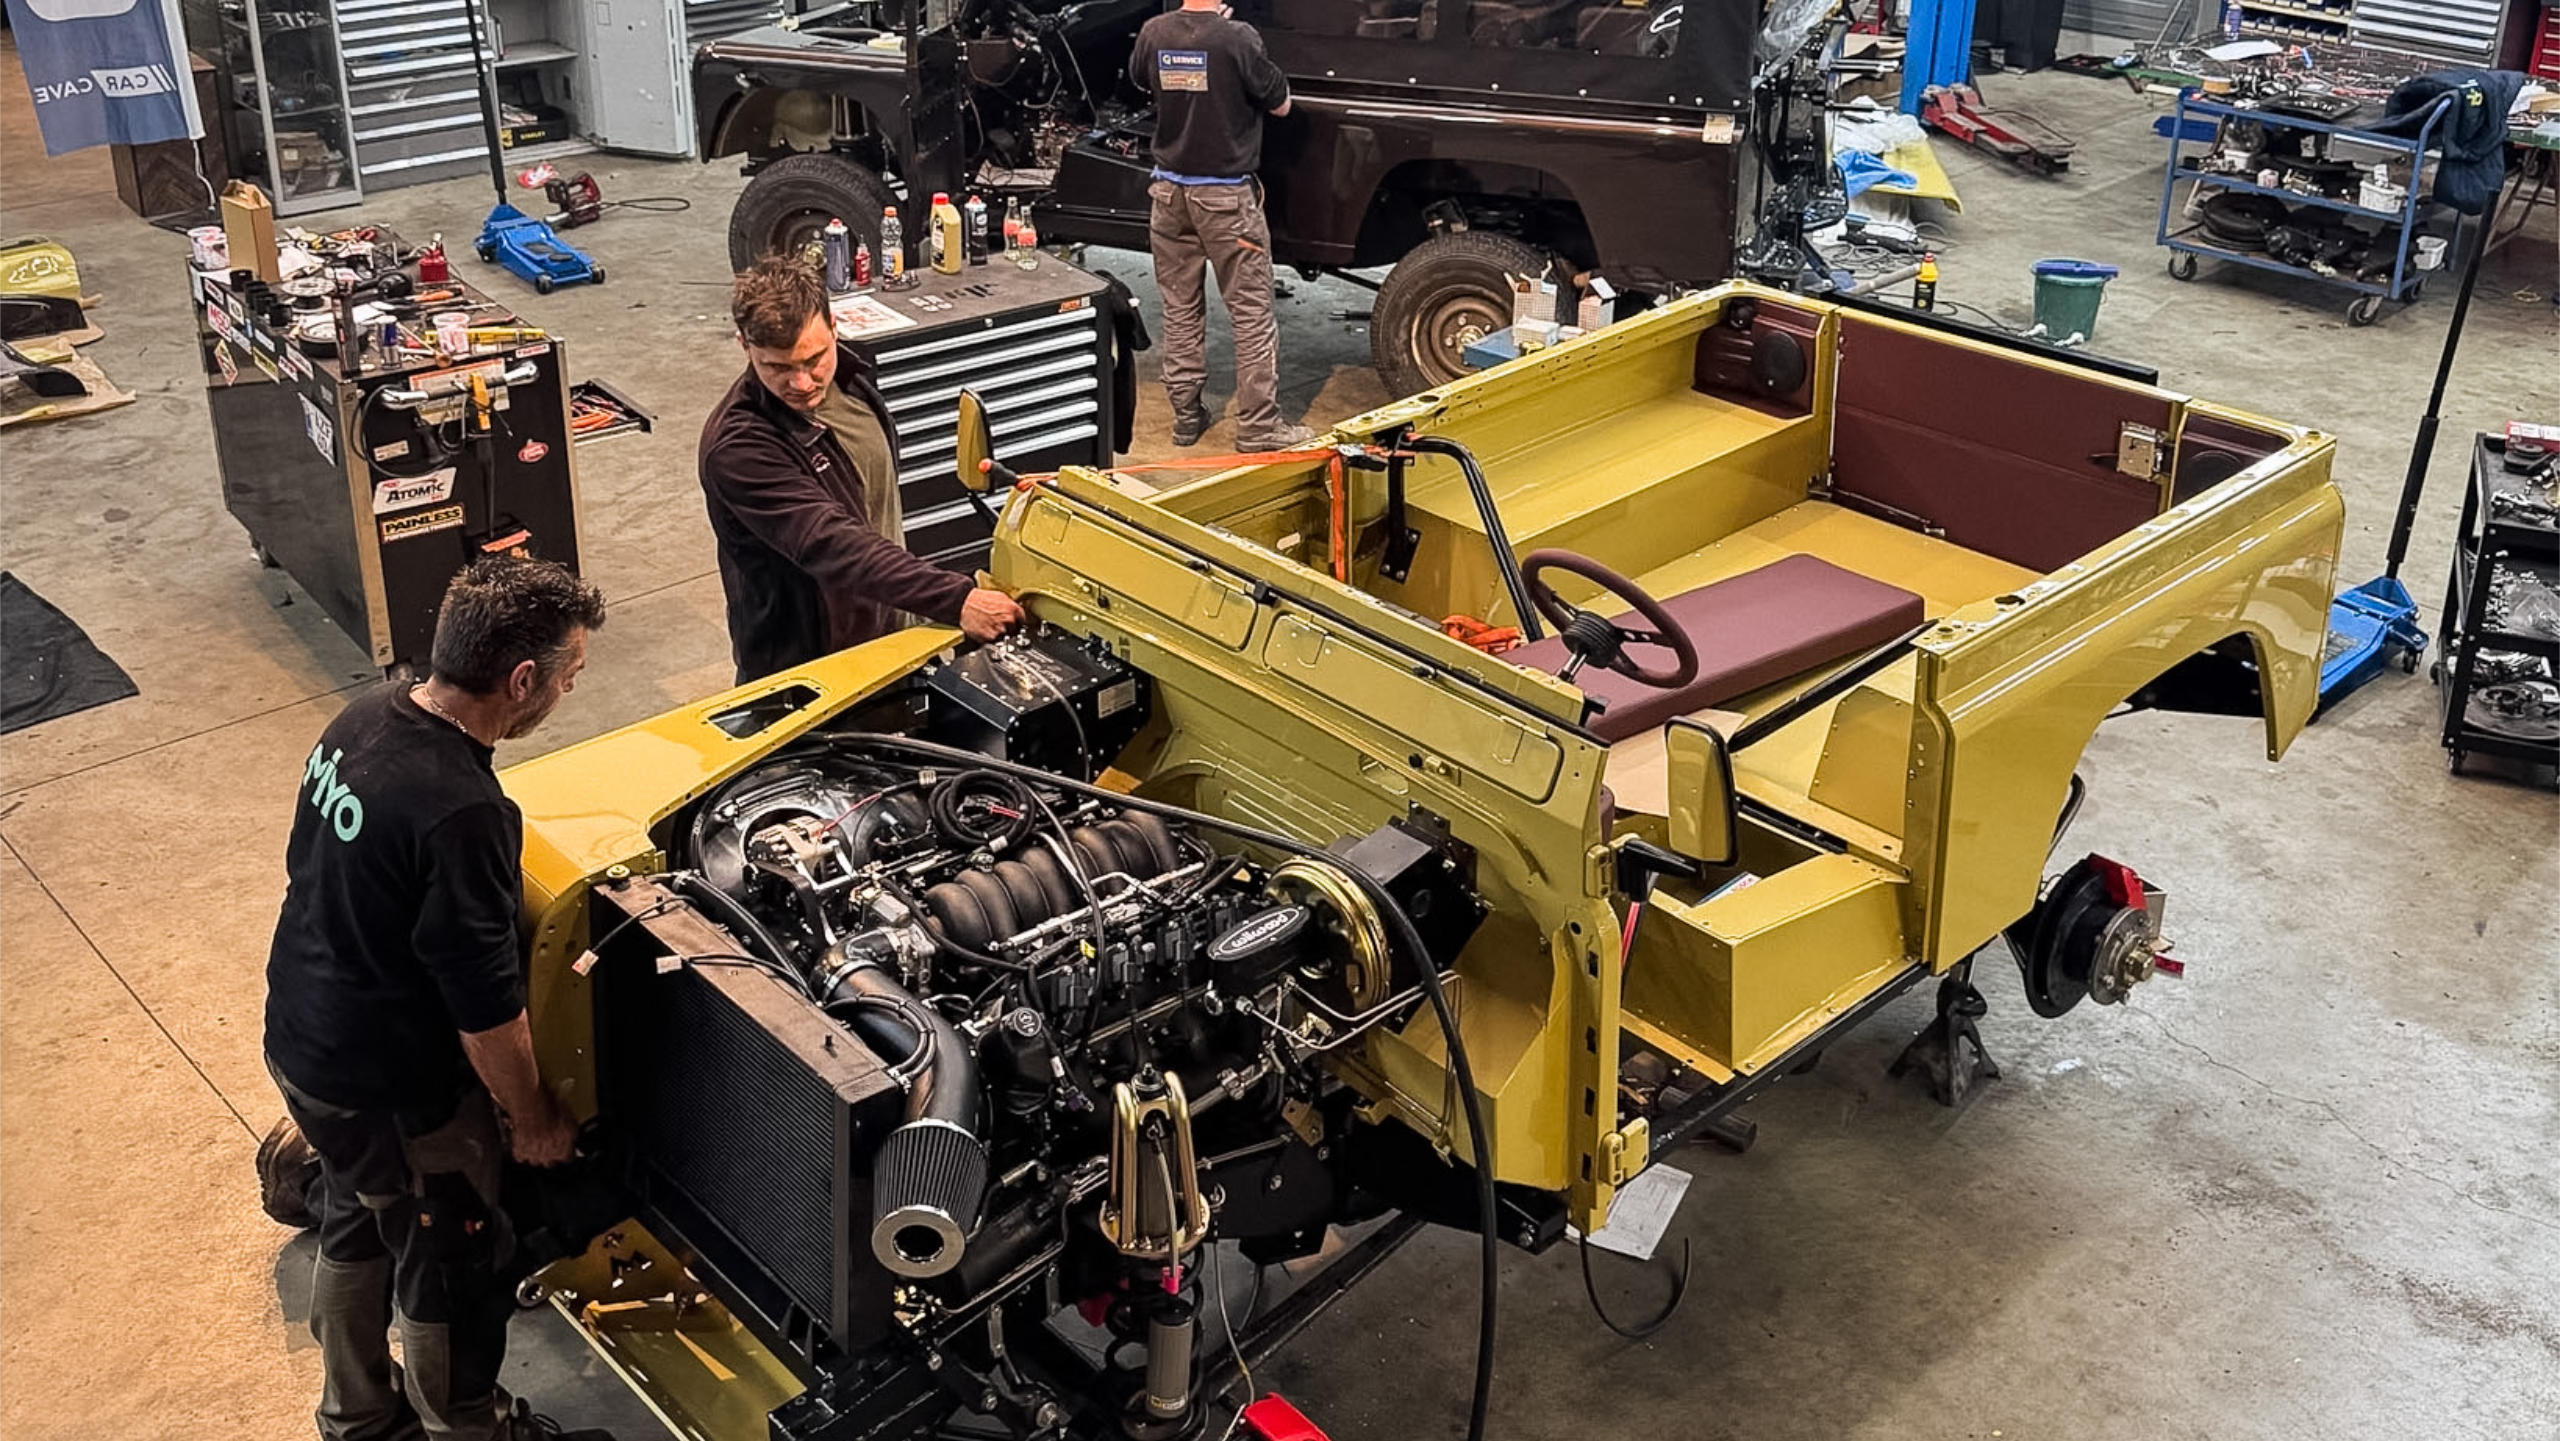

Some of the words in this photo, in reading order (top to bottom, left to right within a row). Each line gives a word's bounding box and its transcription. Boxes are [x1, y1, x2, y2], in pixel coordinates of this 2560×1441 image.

[1172, 55, 1203, 65] SERVICE
[385, 508, 461, 533] PAINLESS
[1231, 912, 1288, 947] wilwood
